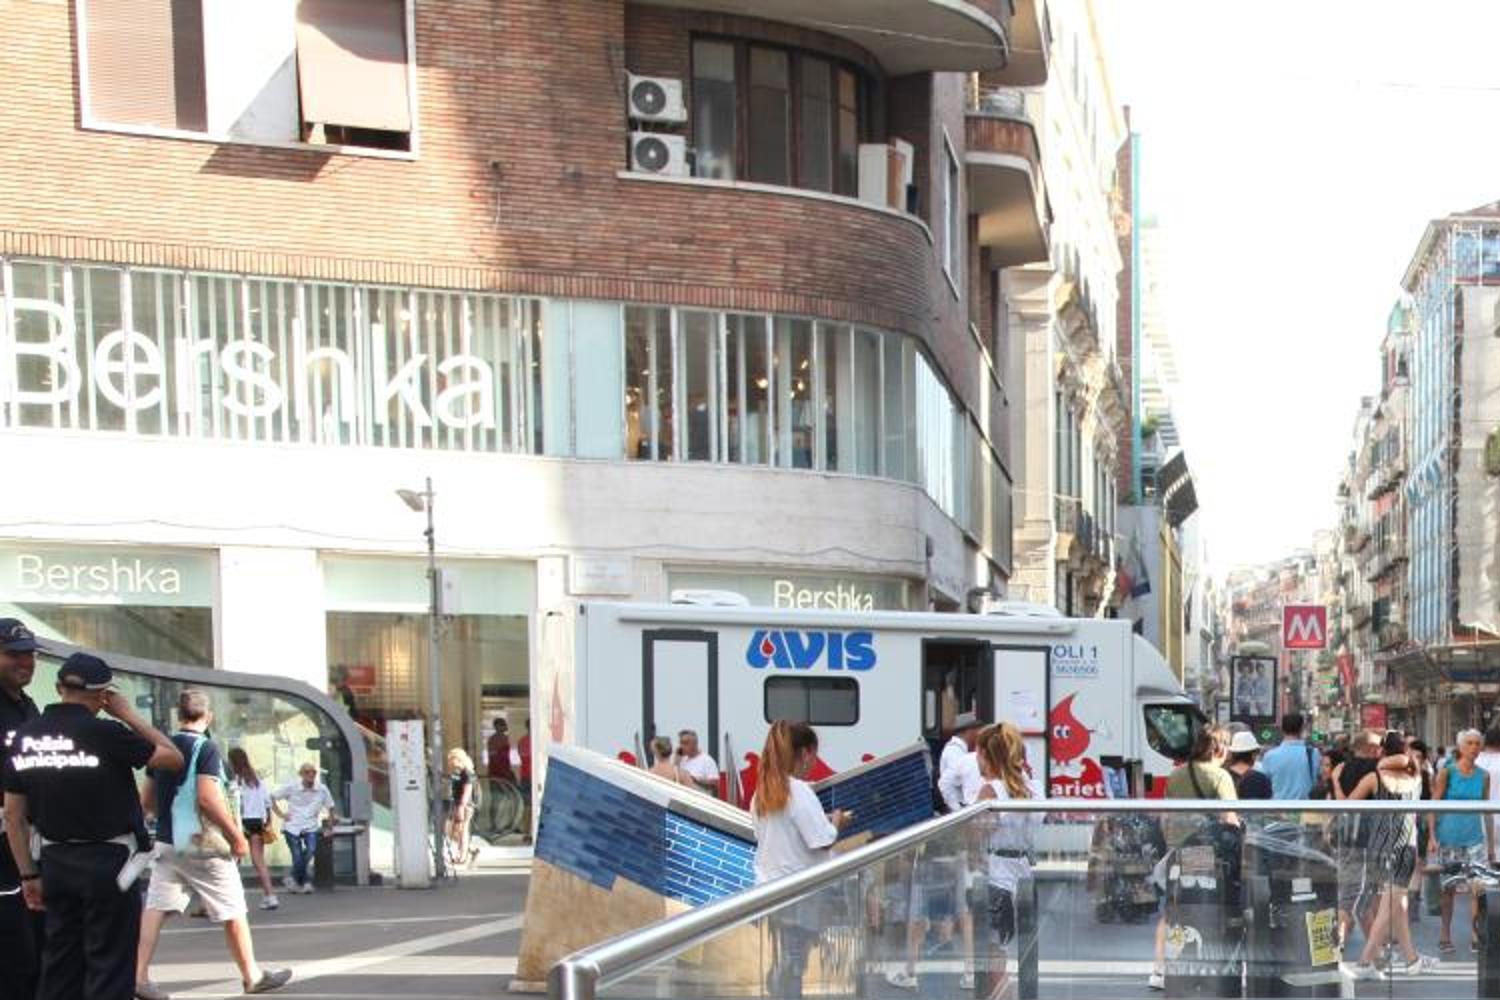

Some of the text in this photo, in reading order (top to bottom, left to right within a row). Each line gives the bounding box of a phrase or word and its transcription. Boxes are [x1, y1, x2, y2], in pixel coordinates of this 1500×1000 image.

[6, 298, 497, 431] Bershka
[16, 555, 181, 594] Bershka
[773, 578, 873, 615] Bershka
[745, 629, 877, 671] AVIS
